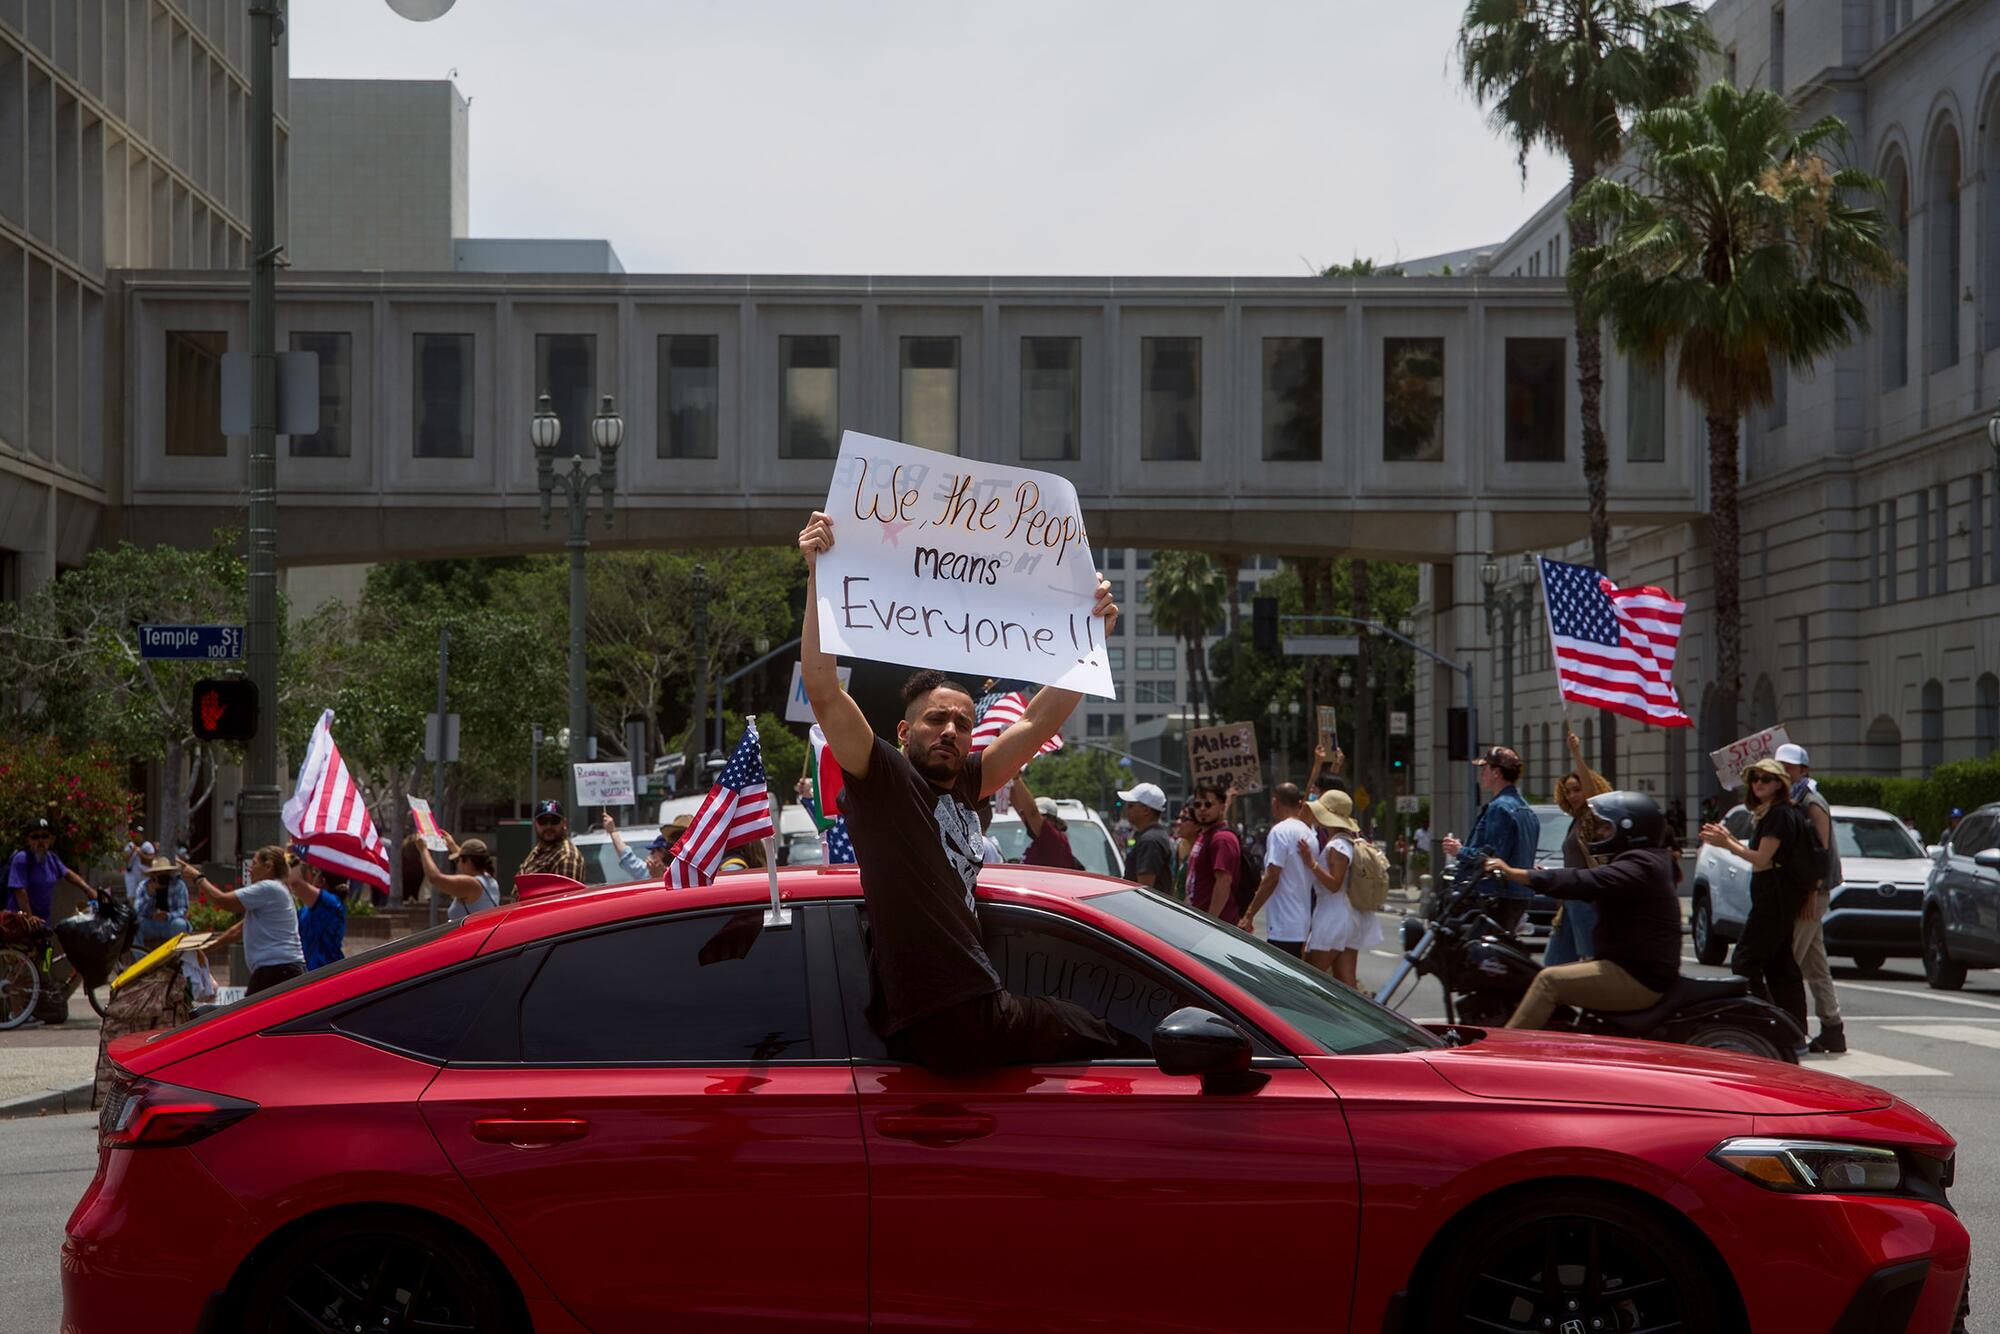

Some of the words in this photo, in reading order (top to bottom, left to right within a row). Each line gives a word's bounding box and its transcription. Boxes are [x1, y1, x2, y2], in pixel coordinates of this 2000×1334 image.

[932, 474, 1001, 532] the
[914, 545, 1001, 585] means
[143, 627, 199, 650] Temple
[221, 627, 239, 646] St
[208, 644, 227, 658] 100
[231, 645, 240, 658] E
[1193, 731, 1241, 755] Make
[1728, 733, 1772, 764] STOP
